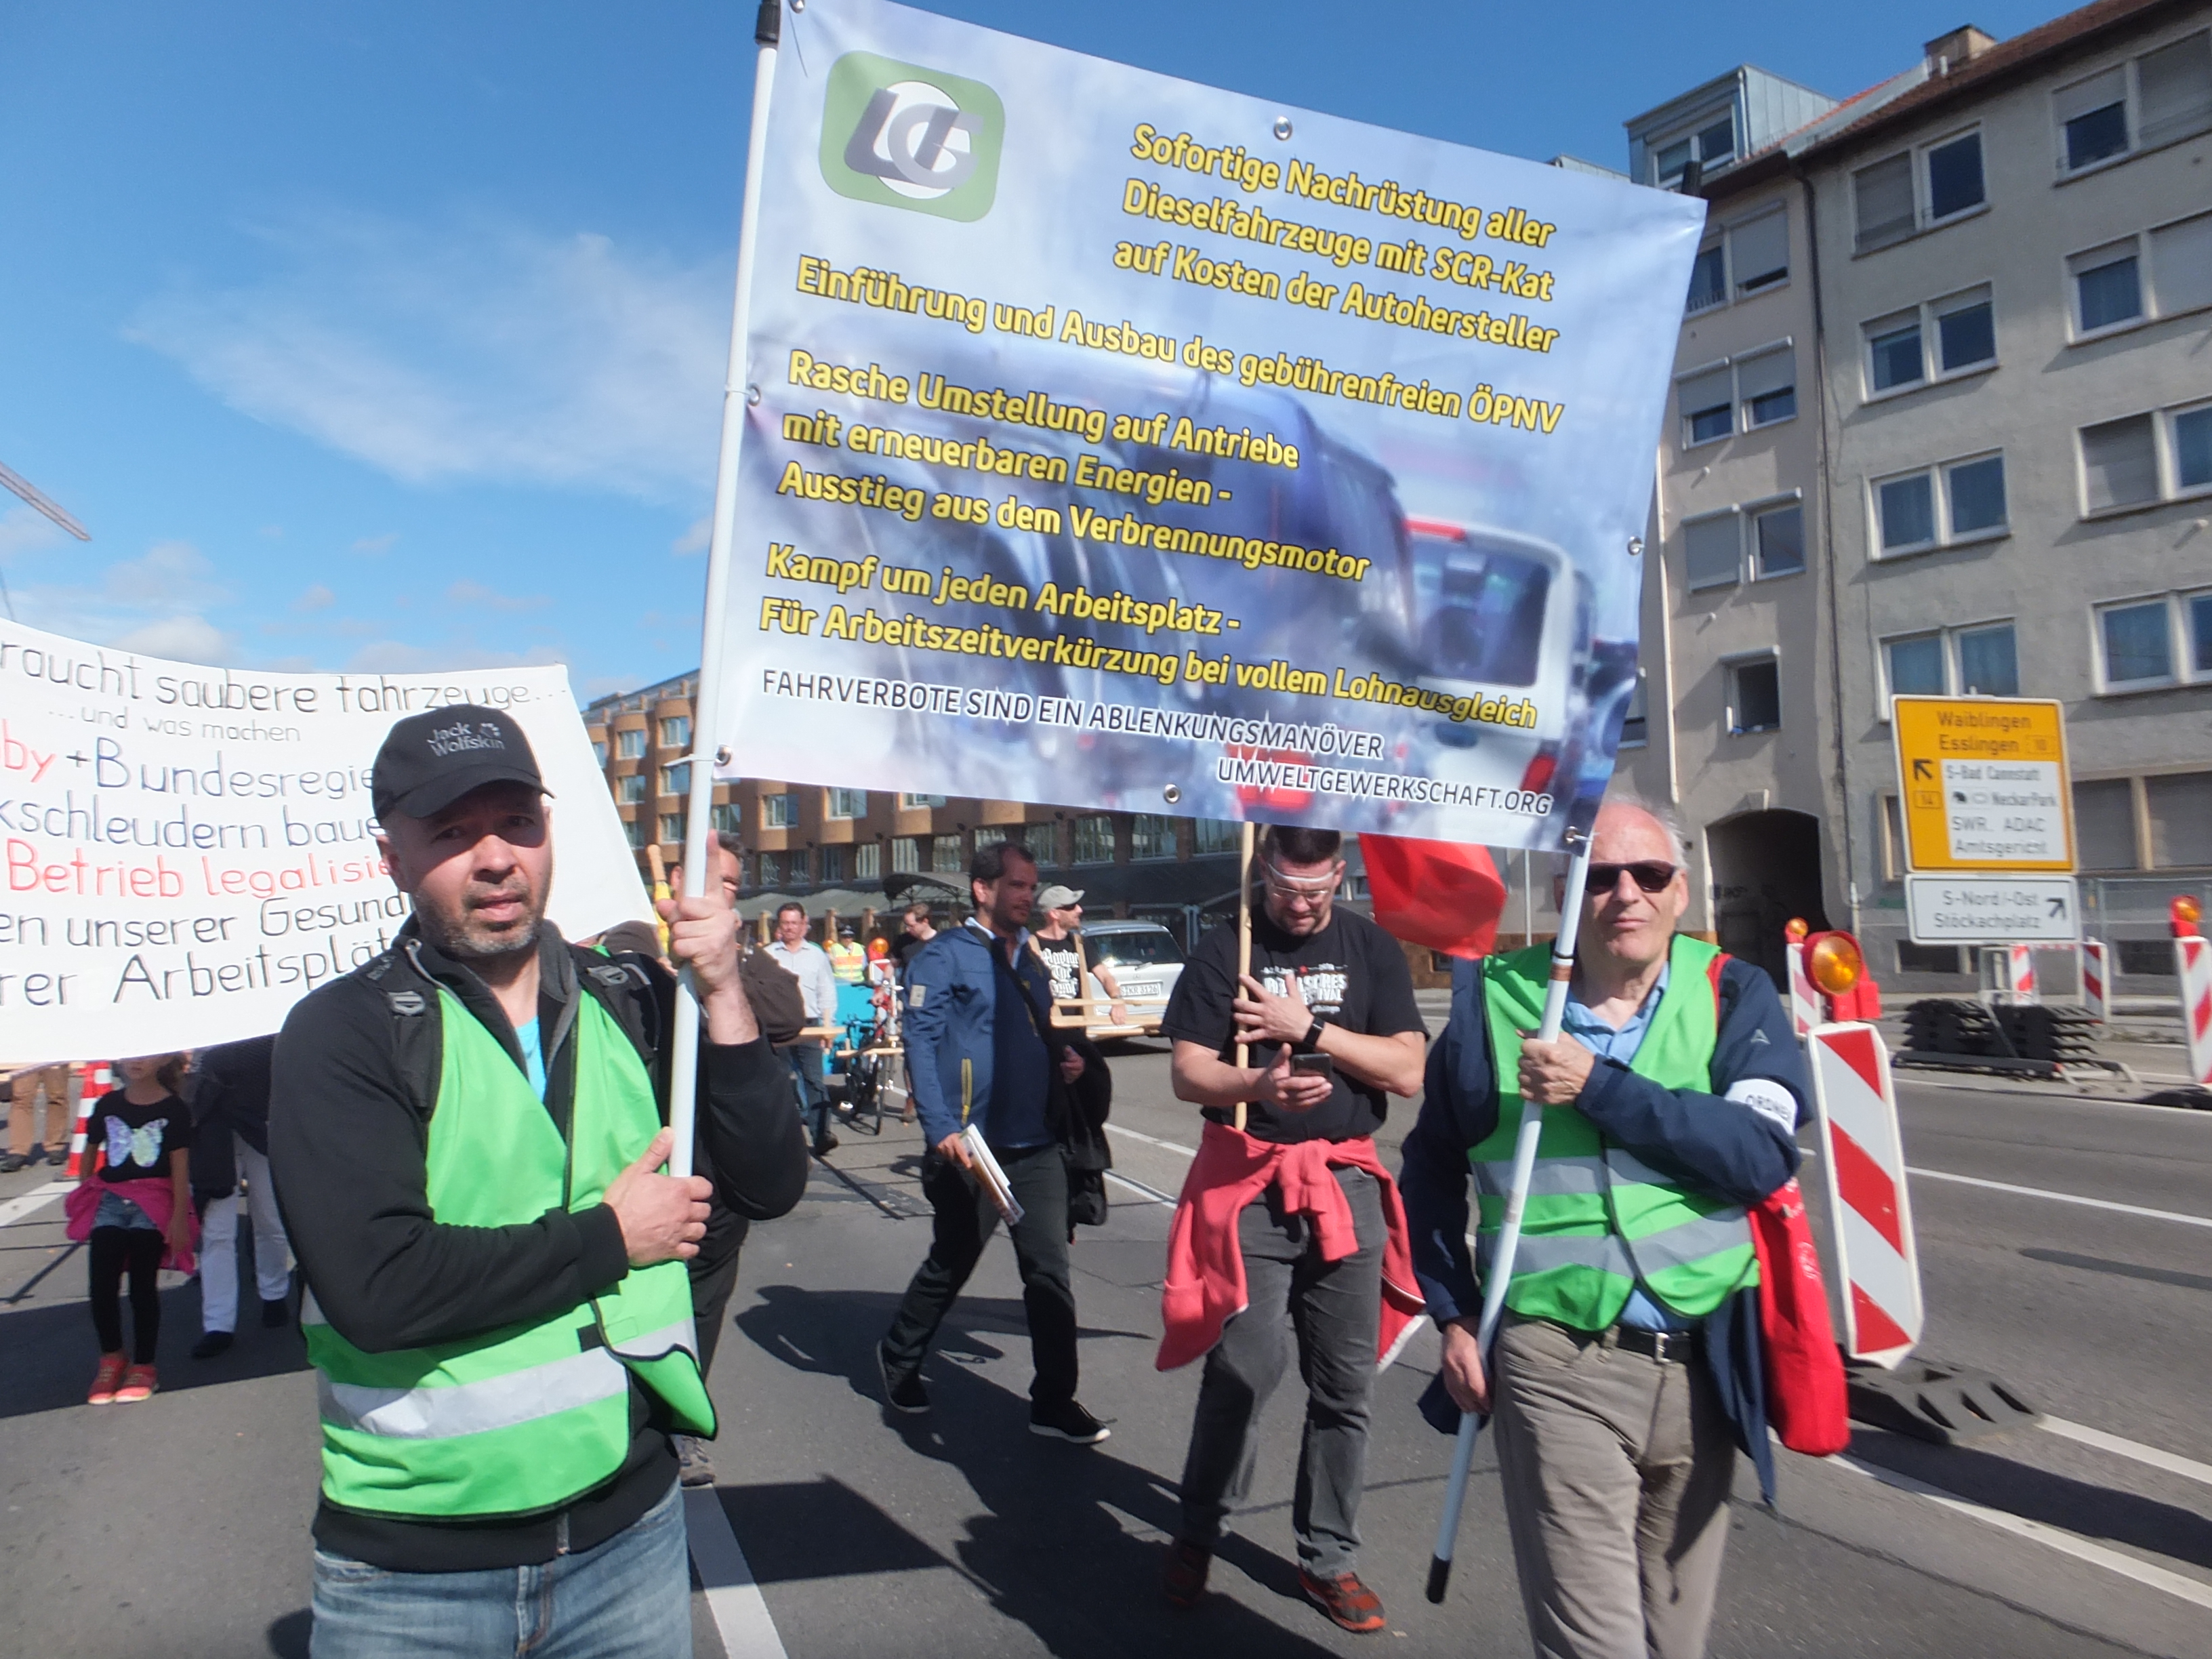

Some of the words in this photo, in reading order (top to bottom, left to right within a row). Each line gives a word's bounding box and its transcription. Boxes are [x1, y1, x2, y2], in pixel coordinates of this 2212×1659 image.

[1130, 123, 1279, 192] Sofortige
[1286, 159, 1481, 239] Nachrüstung
[1486, 207, 1556, 248] aller
[1123, 178, 1371, 267] Dieselfahrzeuge
[1375, 241, 1427, 276] mit
[1431, 247, 1555, 302] SCR-Kat
[1114, 240, 1171, 274] auf
[1172, 247, 1279, 300] Kosten
[1286, 270, 1338, 309] der
[1340, 281, 1559, 353] Autohersteller
[796, 255, 985, 332] Einführung
[994, 300, 1054, 339] und
[1060, 310, 1175, 362] Ausbau
[1183, 336, 1233, 374] des
[1240, 352, 1460, 417] gebührenfreien
[1467, 384, 1564, 433] ÖPNV
[788, 349, 909, 403] Rasche
[917, 372, 1107, 443] Umstellung
[1112, 412, 1170, 445] auf
[1170, 417, 1298, 469] Antriebe
[783, 410, 841, 447] mit
[847, 423, 1068, 483] erneuerbaren
[1074, 453, 1212, 505] Energien
[776, 461, 925, 521] Ausstieg
[931, 493, 989, 525] aus
[996, 495, 1061, 534] dem
[1069, 504, 1371, 581] Verbrennungsmotor
[766, 542, 878, 593] Kampf
[881, 565, 931, 595] um
[933, 567, 1028, 609] jeden
[1034, 582, 1223, 634] Arbeitsplatz
[155, 668, 318, 713] saubere
[759, 596, 819, 634] Für
[823, 605, 1178, 684] Arbeitszeitverkürzung
[1185, 651, 1227, 684] bei
[1235, 661, 1327, 696] vollem
[1332, 668, 1538, 729] Lohnausgleich
[143, 716, 191, 737] was
[202, 720, 300, 741] machen
[427, 722, 472, 743] Jack
[763, 670, 960, 713] FAHRVERBOTE
[967, 690, 1031, 720] SIND
[1038, 699, 1083, 726] EIN
[1088, 705, 1383, 758] ABLENKUNGSMANÖVER
[1937, 711, 2032, 732] Waiblingen
[430, 735, 505, 756] Wolfskin
[1939, 734, 2019, 755] Esslingen
[1219, 760, 1552, 815] UMWELTGEWERKSCHAFT.ORG
[2003, 817, 2047, 832] ADAC
[6, 838, 184, 898] Betrieb
[67, 913, 237, 947] unserer
[1933, 913, 2042, 931] Stöckachplatz
